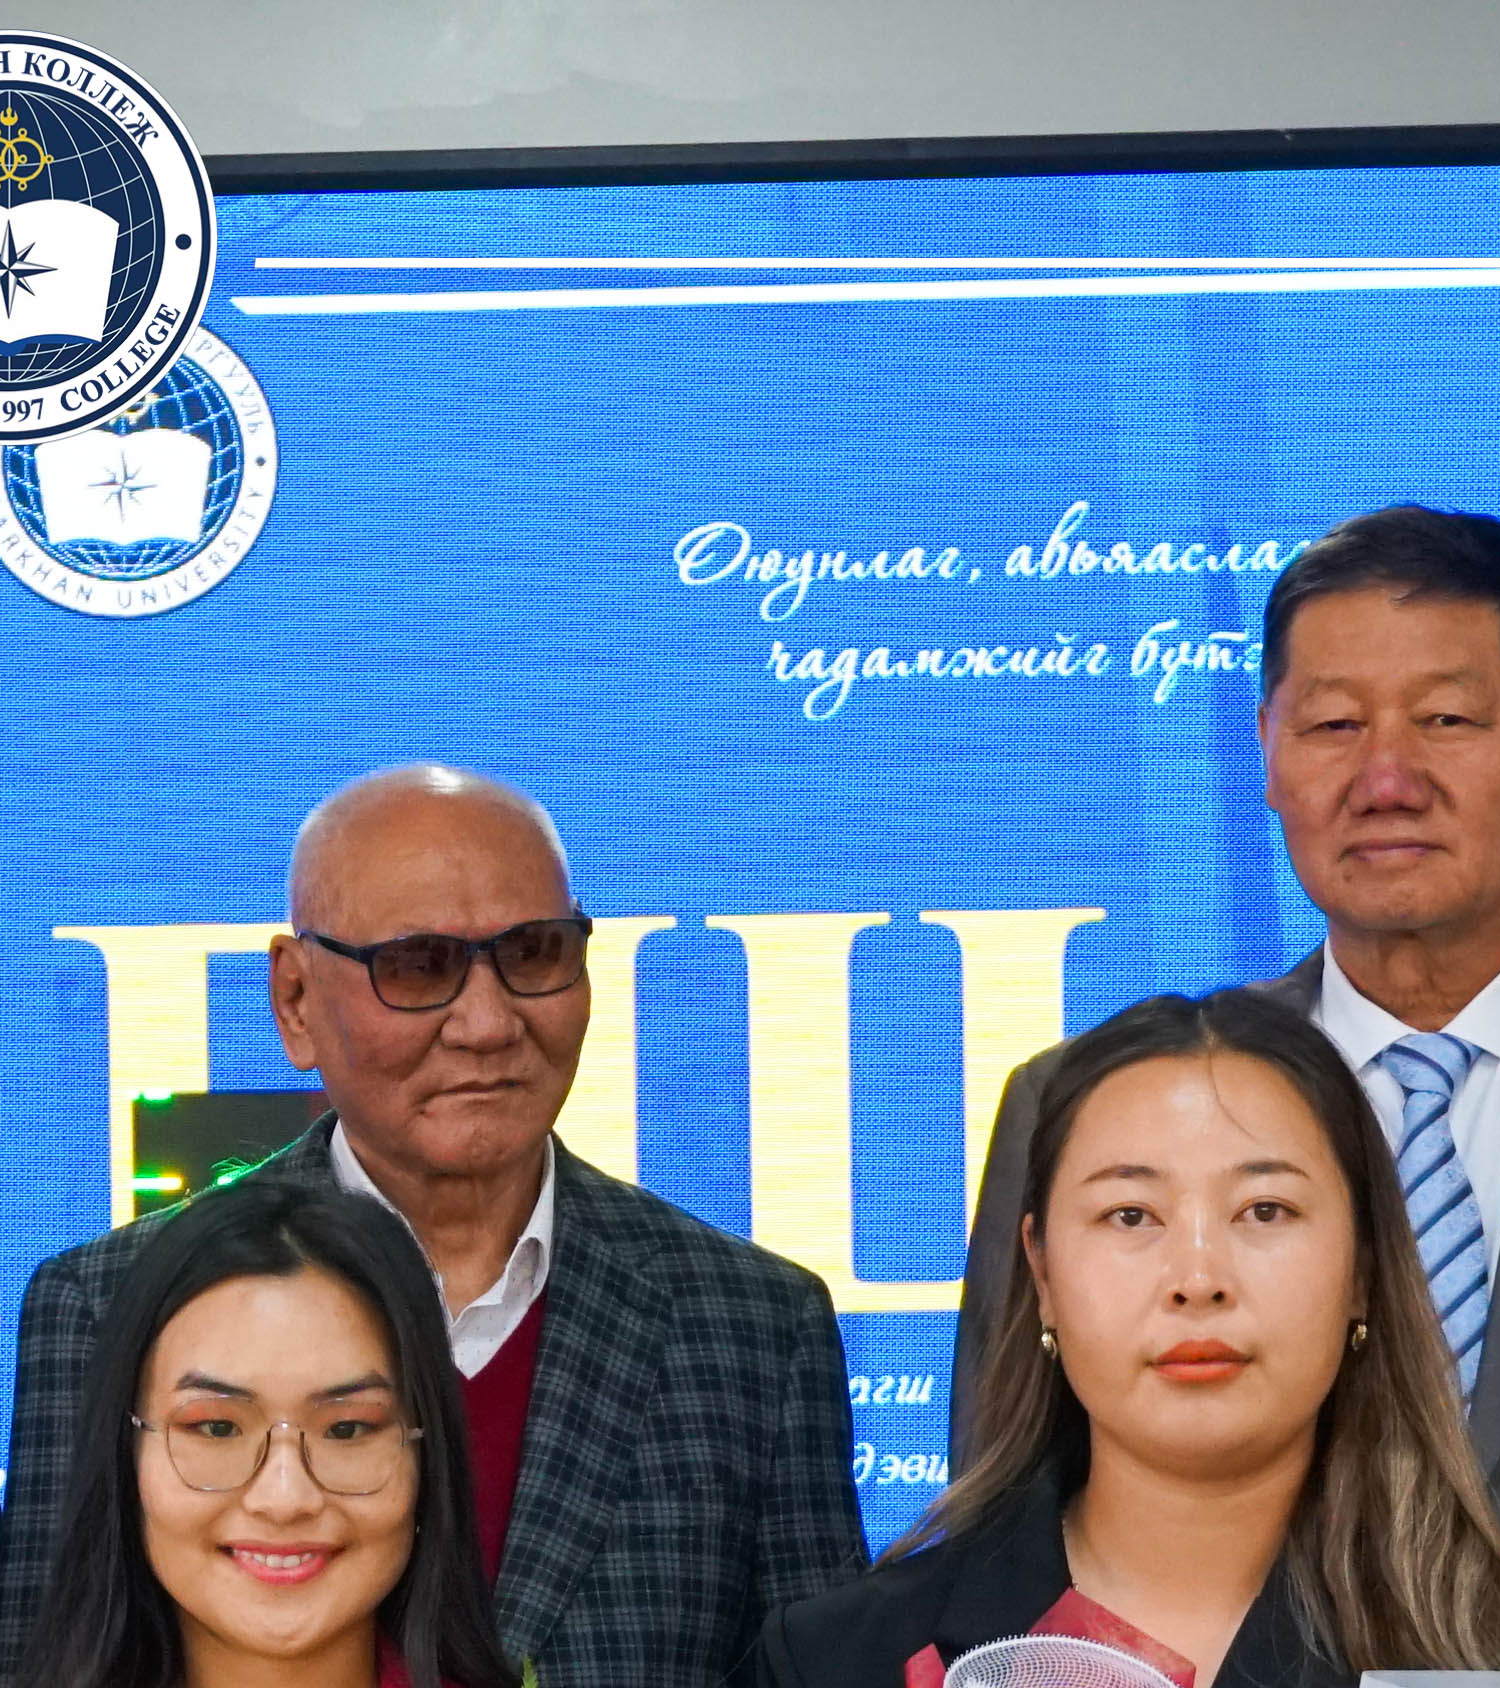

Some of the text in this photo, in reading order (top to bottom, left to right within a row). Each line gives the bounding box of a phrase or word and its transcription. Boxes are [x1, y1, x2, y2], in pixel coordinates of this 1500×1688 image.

[116, 488, 264, 610] UNIVERSITY
[1005, 500, 1311, 579] авьяасла
[765, 632, 1108, 721] чадамжийг
